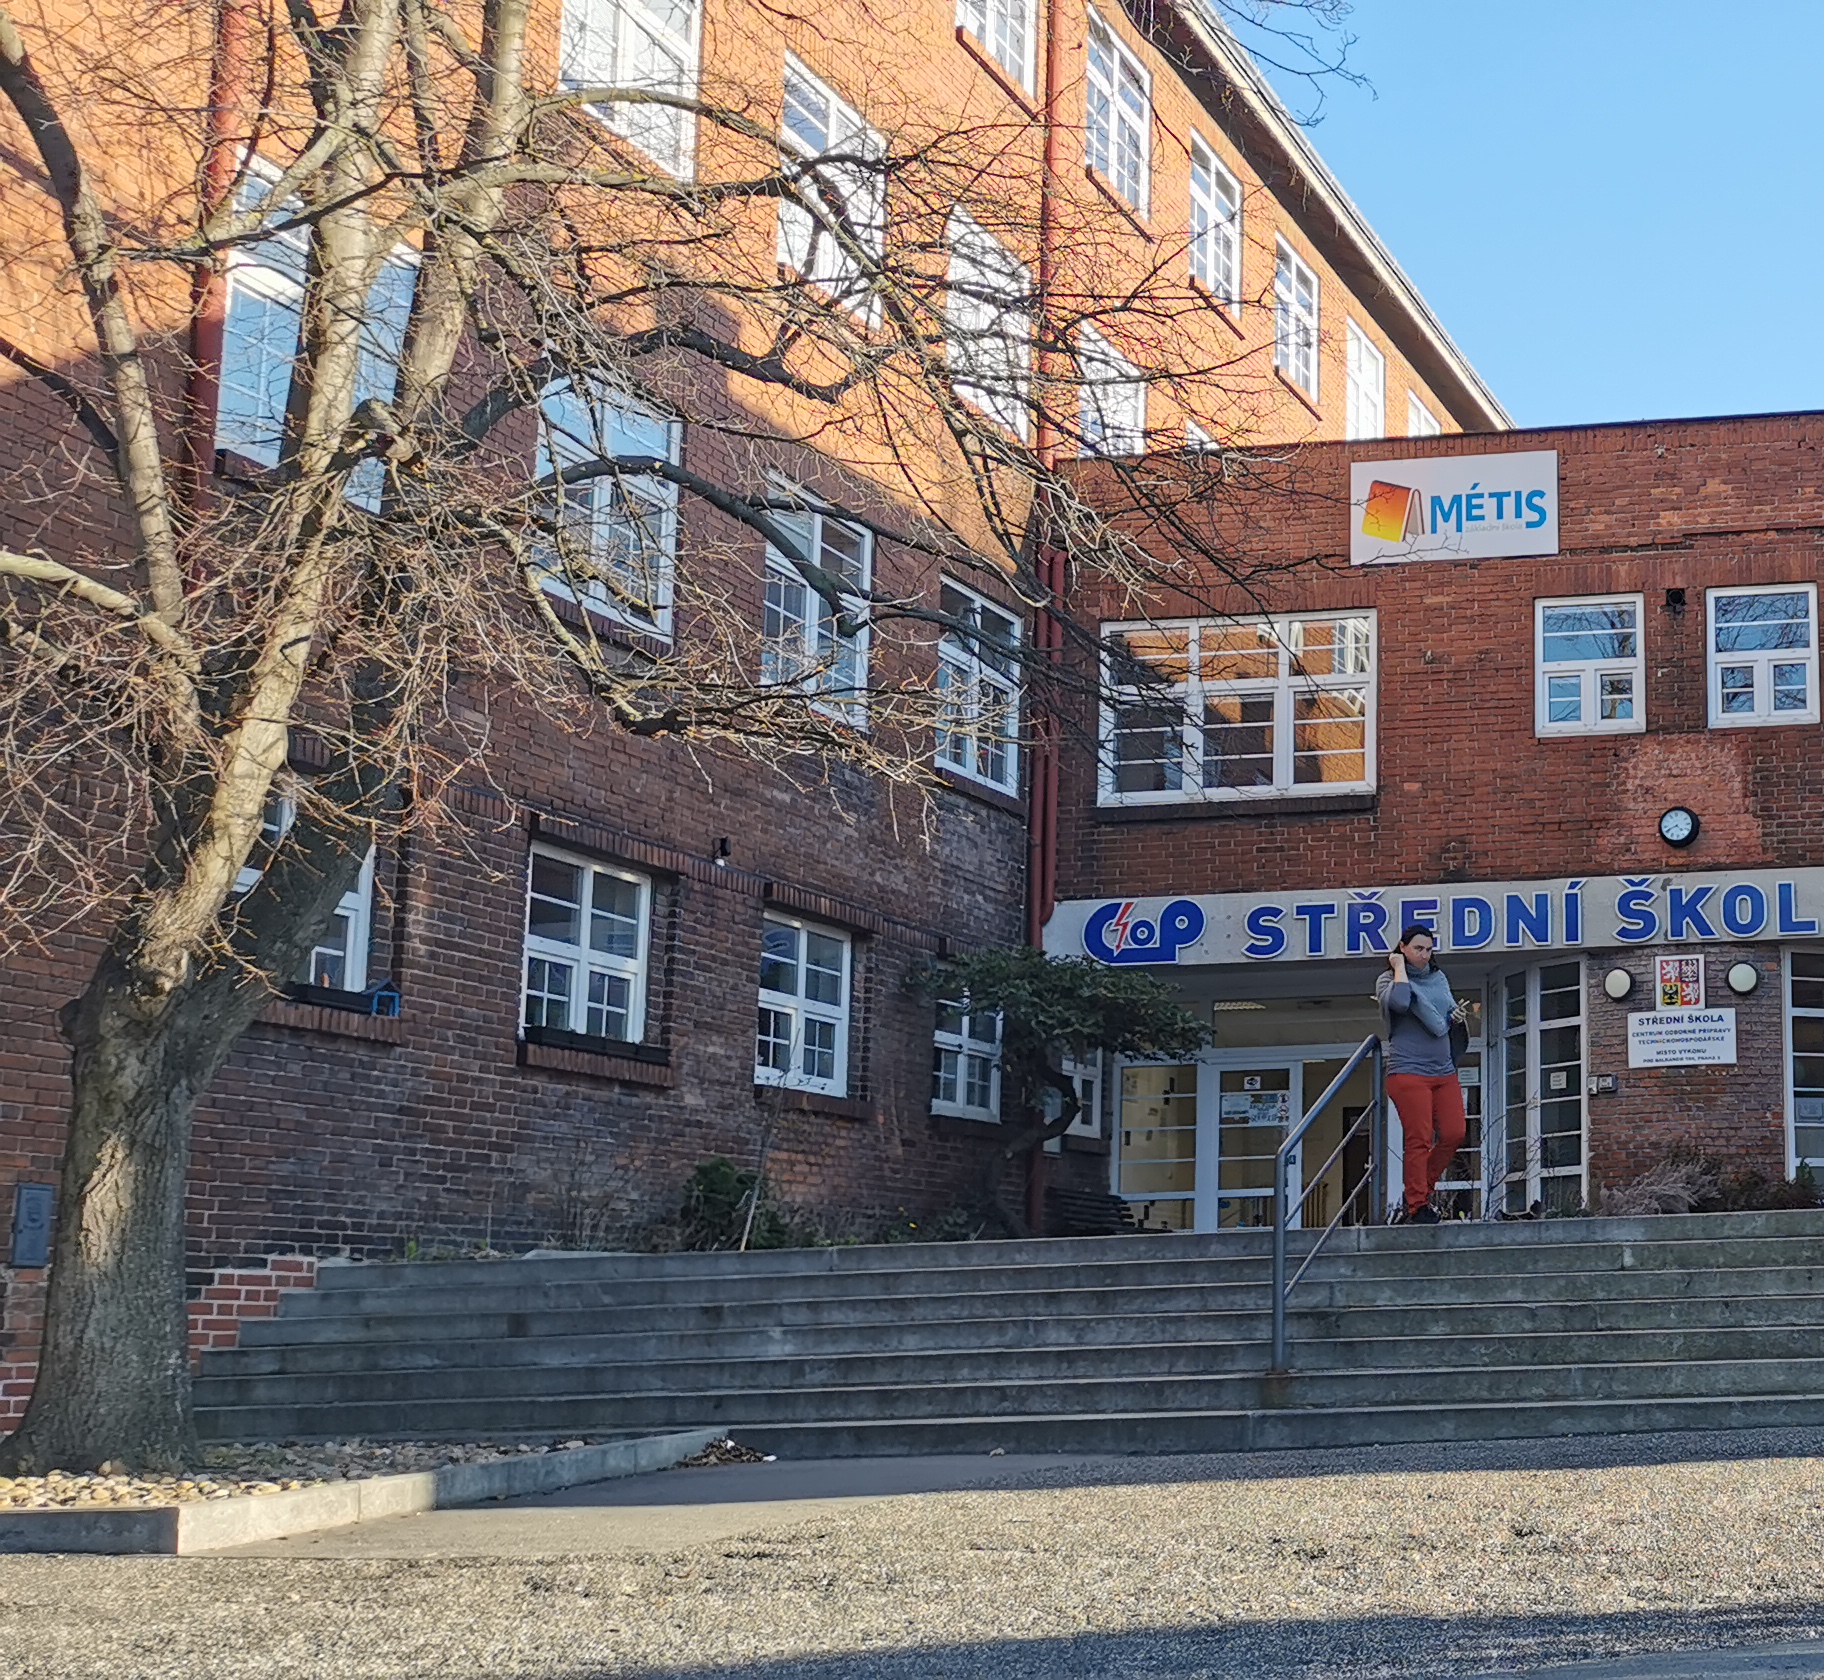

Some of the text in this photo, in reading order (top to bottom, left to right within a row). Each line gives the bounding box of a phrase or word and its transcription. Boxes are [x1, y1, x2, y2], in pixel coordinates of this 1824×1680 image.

[1430, 482, 1547, 535] MÉTIS
[1501, 521, 1523, 532] škola
[1241, 879, 1588, 960] STŘEDNÍ
[1638, 1013, 1725, 1026] STŘEDNÍ ŠKOLA
[1631, 1030, 1663, 1038] CENTRUM
